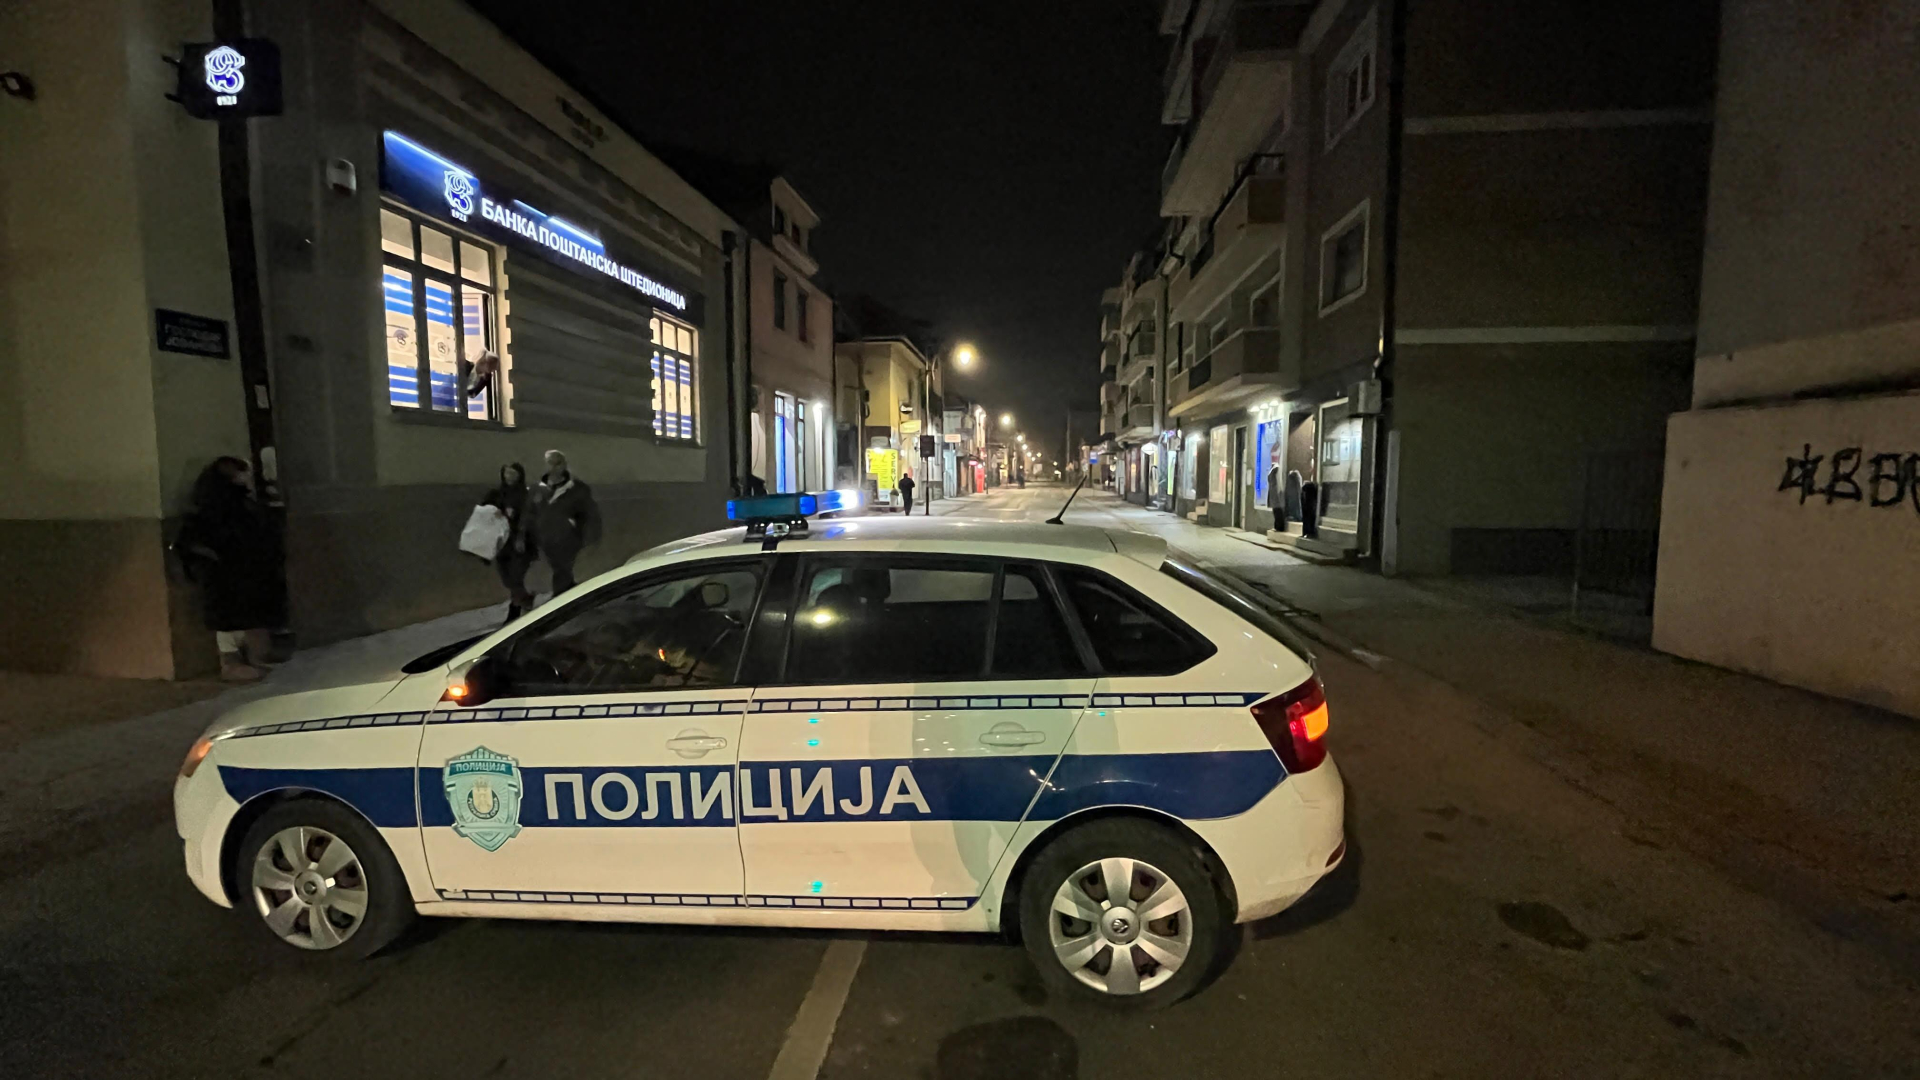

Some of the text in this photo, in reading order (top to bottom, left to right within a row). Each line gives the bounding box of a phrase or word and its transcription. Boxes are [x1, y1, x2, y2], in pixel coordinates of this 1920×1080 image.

[481, 197, 686, 310] БАНКА ПОШТАНСКА ШТЕДИОНИЦА
[455, 762, 506, 772] ПОЛИЦИЈА
[543, 765, 932, 821] ПОЛИЦИЈА
